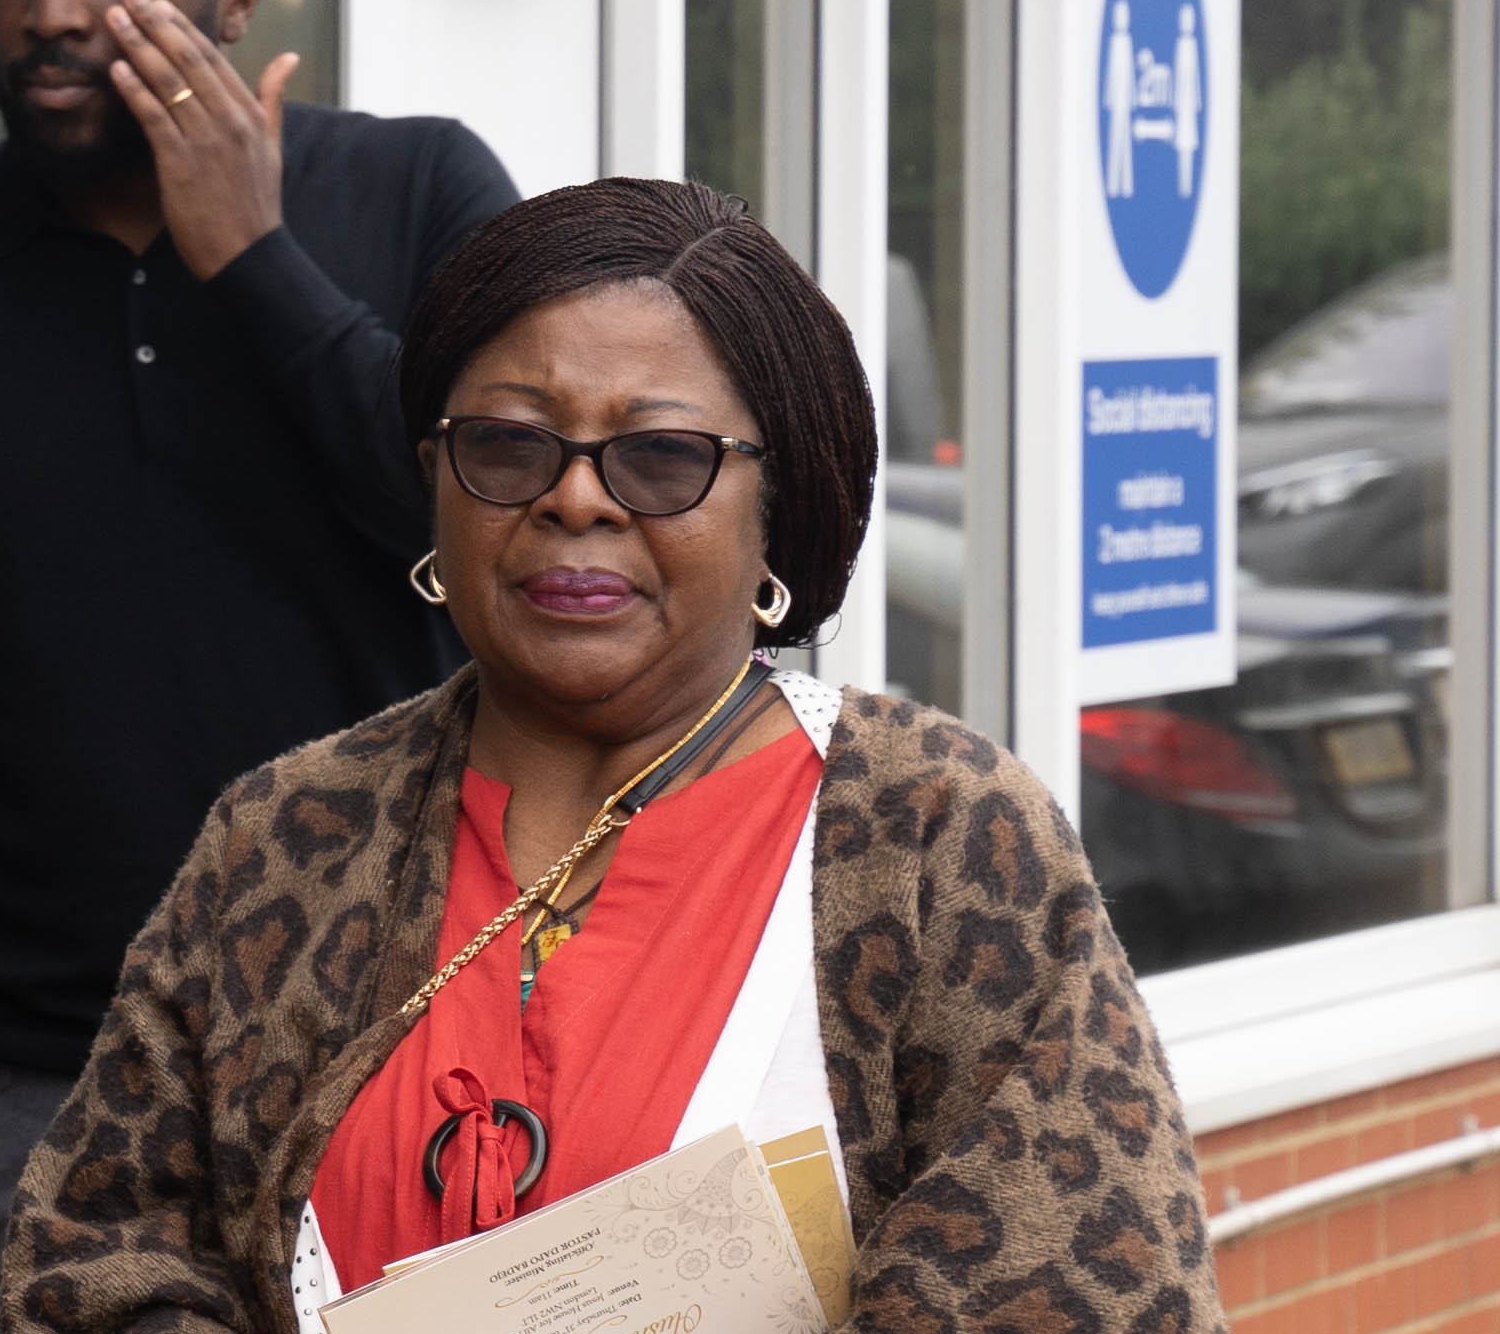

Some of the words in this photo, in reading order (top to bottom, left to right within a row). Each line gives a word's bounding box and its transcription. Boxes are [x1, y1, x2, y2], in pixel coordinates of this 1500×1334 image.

[560, 1227, 602, 1251] PASTOR
[530, 1246, 560, 1265] DAPO
[545, 1242, 594, 1268] Officiating
[489, 1260, 529, 1284] BADEJO
[563, 1287, 598, 1306] London
[539, 1317, 553, 1328] for
[555, 1304, 582, 1321] House
[577, 1305, 617, 1327] Thursday
